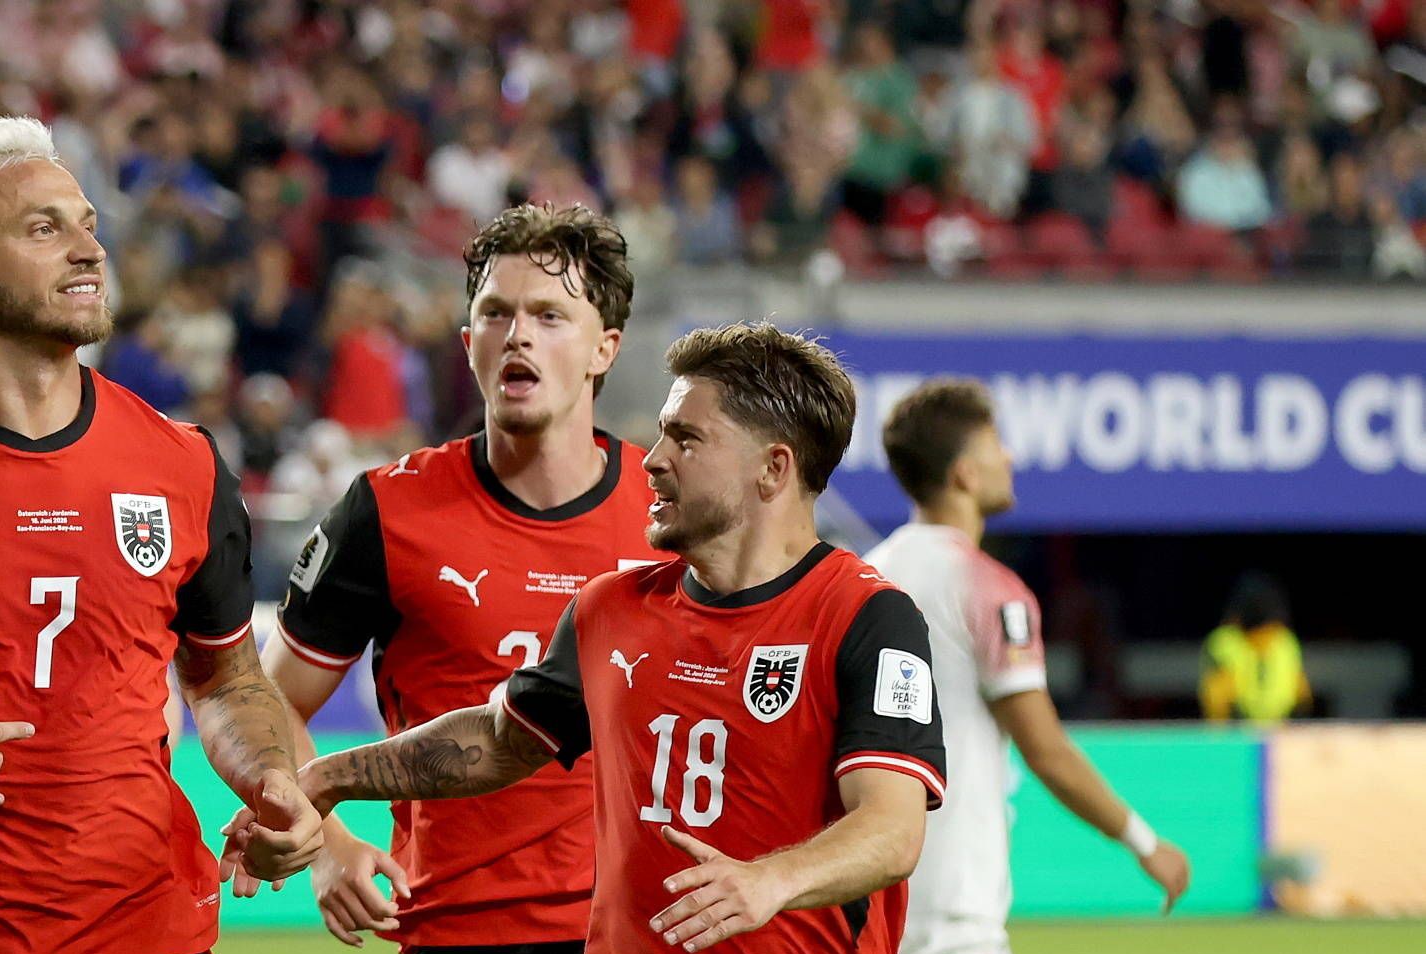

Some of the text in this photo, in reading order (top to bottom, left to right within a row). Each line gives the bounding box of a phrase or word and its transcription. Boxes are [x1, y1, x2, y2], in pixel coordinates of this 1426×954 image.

[992, 372, 1329, 473] WORLD
[29, 576, 81, 689] 7
[893, 692, 918, 705] PEACE
[639, 713, 728, 827] 18
